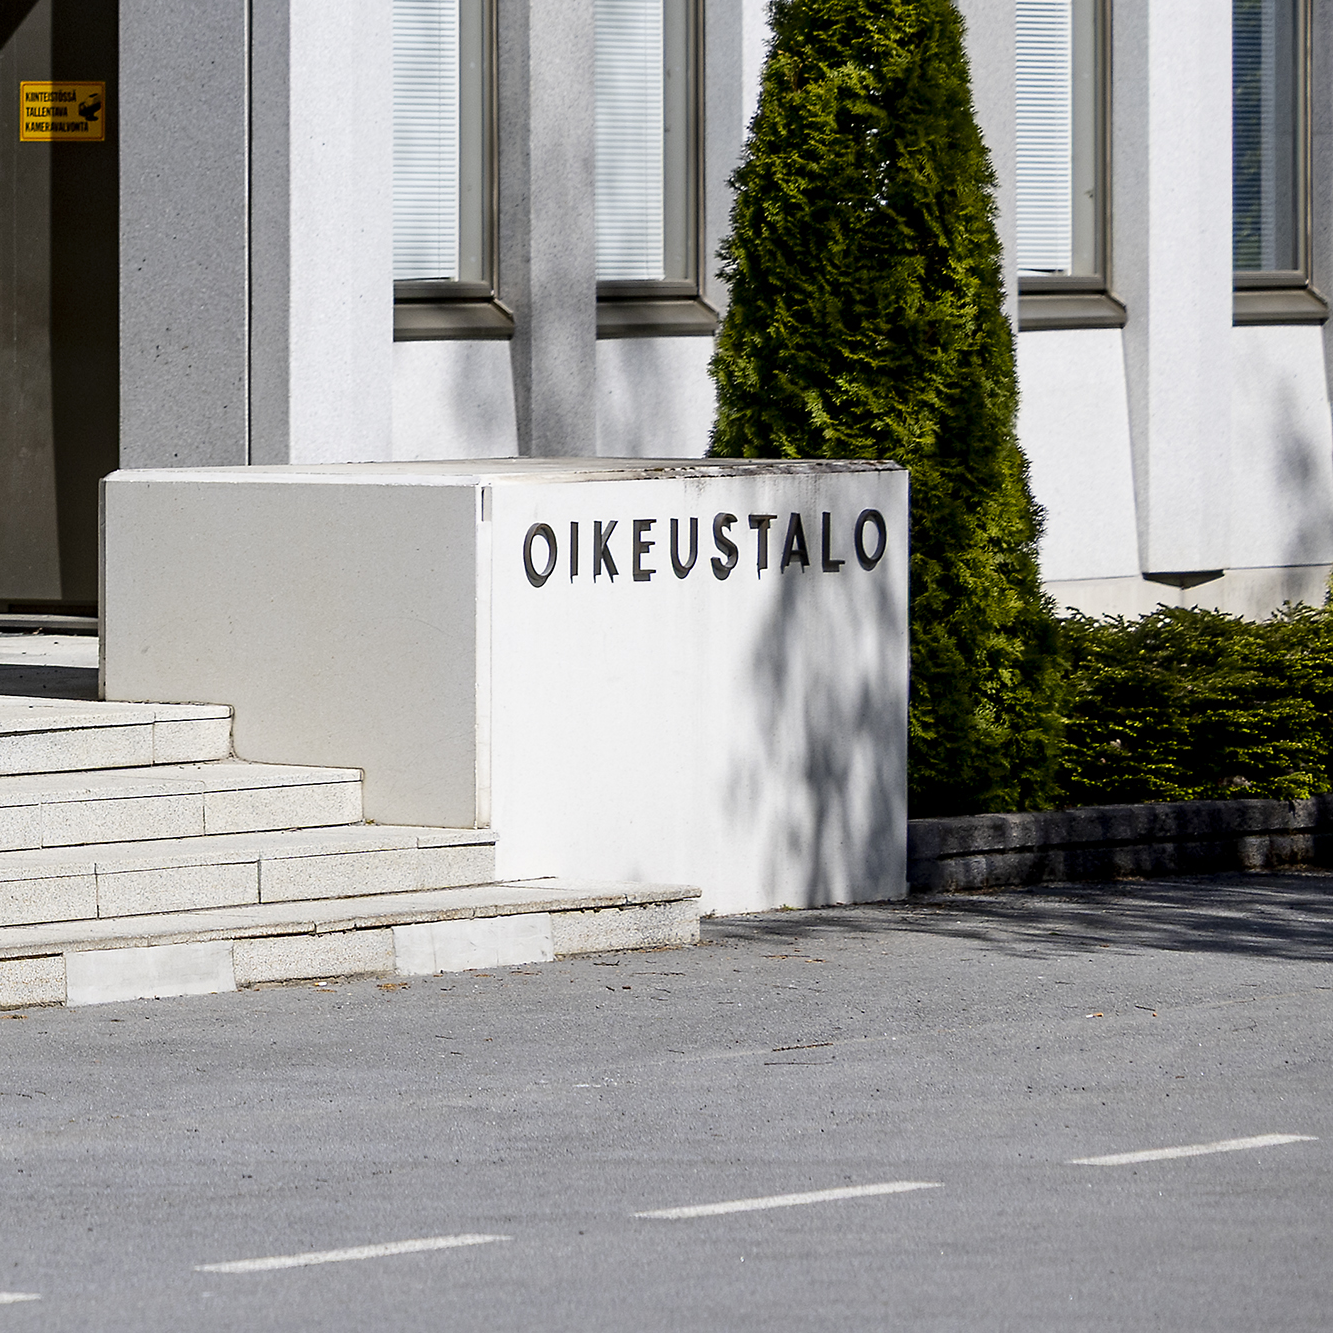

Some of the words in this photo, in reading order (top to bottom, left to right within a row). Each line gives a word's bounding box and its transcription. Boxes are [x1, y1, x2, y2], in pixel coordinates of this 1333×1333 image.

[25, 106, 68, 117] TALLENTAVA
[25, 121, 89, 132] KAMERAVALVONTA
[523, 509, 887, 588] OIKEUSTALO
